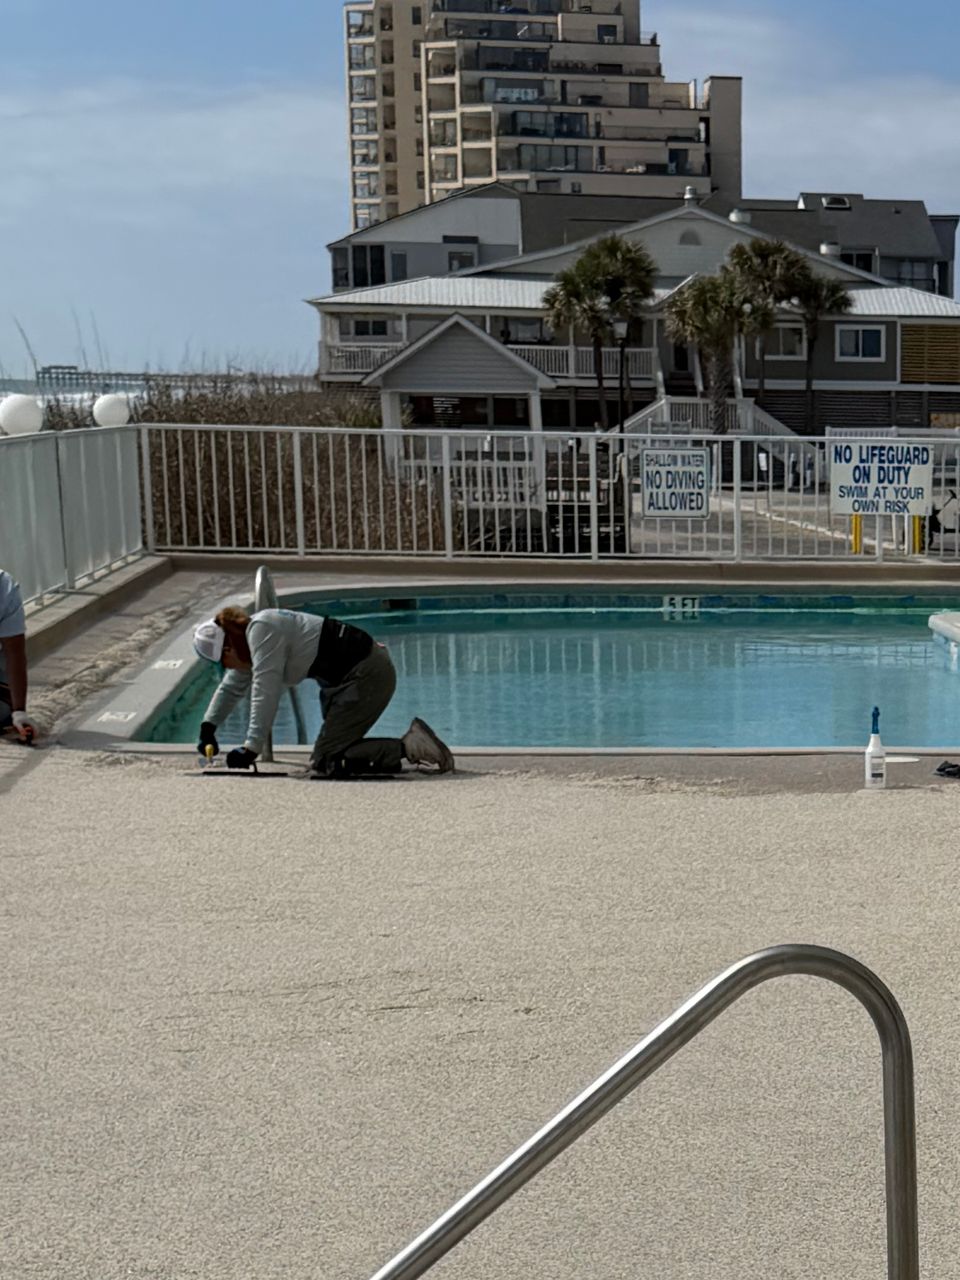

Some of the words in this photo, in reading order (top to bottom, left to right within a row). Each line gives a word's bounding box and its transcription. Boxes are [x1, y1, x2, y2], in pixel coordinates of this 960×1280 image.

[834, 445, 852, 464] NO
[859, 445, 929, 465] LIFEGUARD
[646, 470, 662, 489] NO
[666, 471, 704, 489] DIVING
[852, 465, 870, 484] ON
[878, 466, 911, 484] DUTY
[648, 492, 704, 511] ALLOWED
[839, 485, 868, 498] SWIM
[873, 487, 888, 499] AT
[894, 487, 924, 499] YOUR
[852, 500, 879, 512] OWN
[885, 501, 910, 513] RISK
